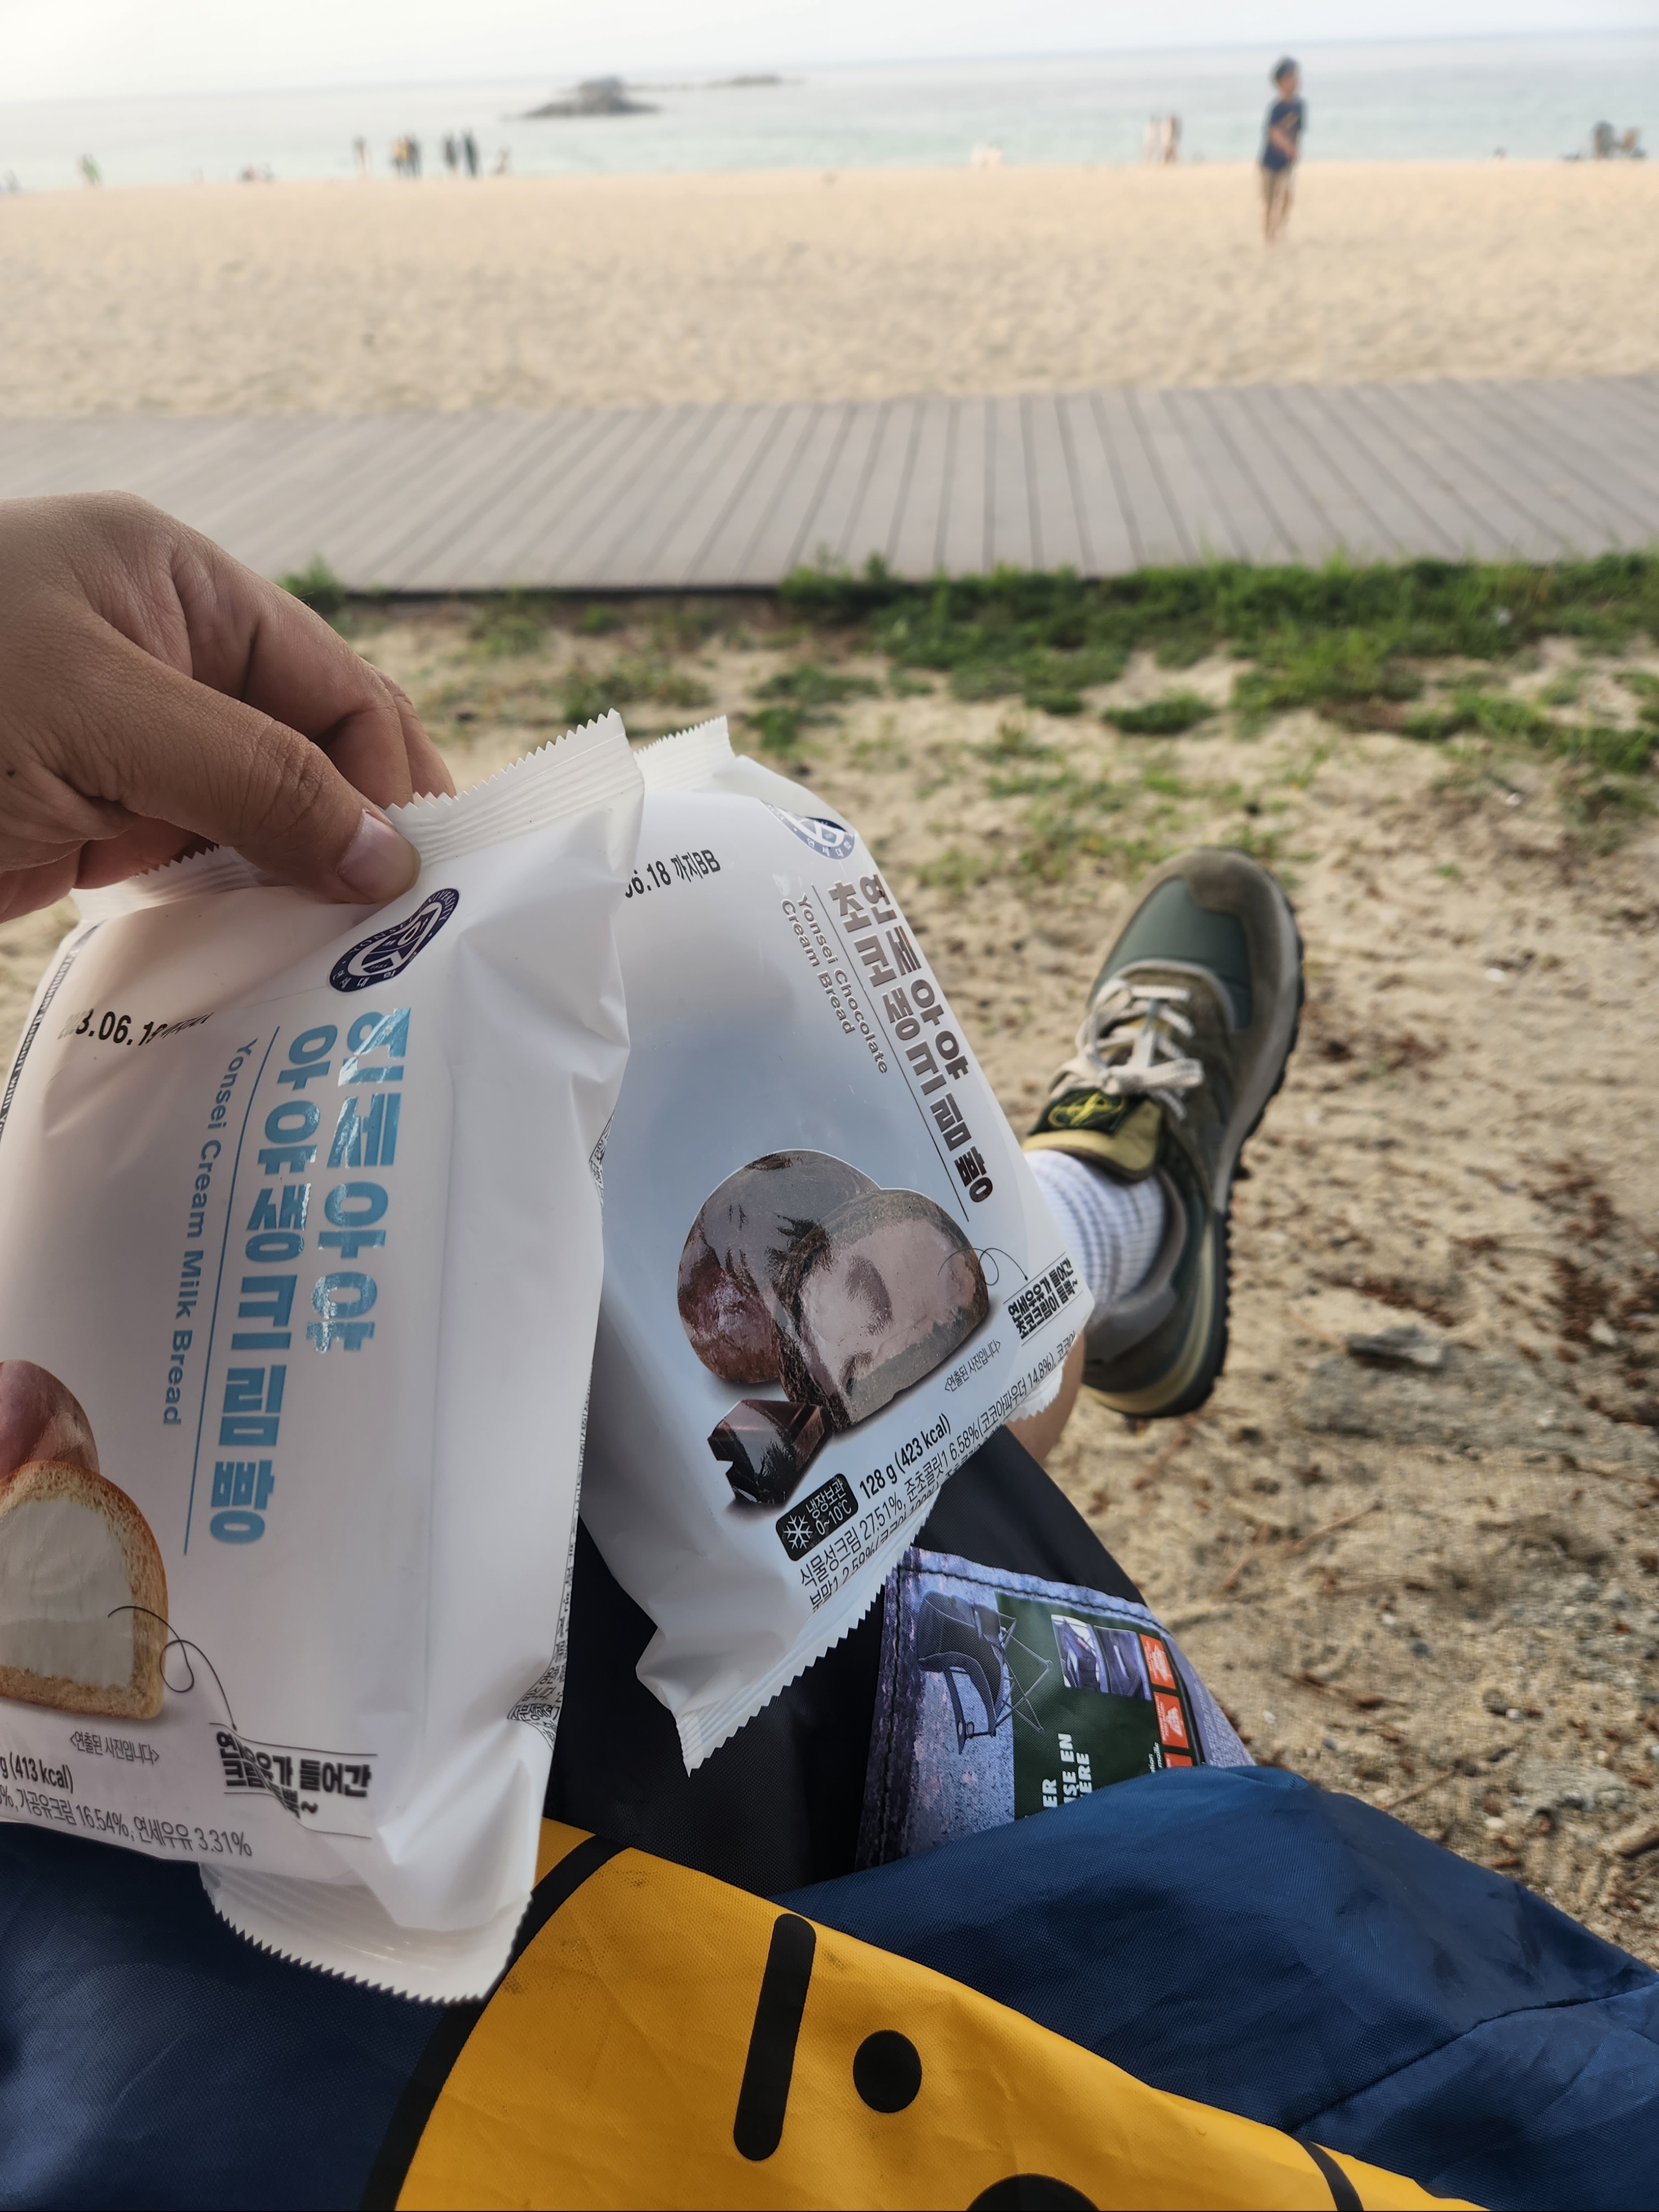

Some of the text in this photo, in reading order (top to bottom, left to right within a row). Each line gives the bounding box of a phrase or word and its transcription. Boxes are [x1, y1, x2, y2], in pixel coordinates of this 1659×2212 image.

[670, 849, 721, 882] 까지BB
[781, 899, 855, 1034] Cream Bread
[797, 893, 888, 1074] Yonsei Chocolate
[859, 874, 969, 1080] 연세우유
[828, 881, 993, 1203] 초코생크림빵
[306, 1008, 411, 1354] 연세우유
[163, 1038, 258, 1425] Yonsei Cream Milk Bread
[209, 1024, 338, 1545] 우유생크림빵
[1008, 1258, 1074, 1323] 연세우유가 들어간
[1016, 1293, 1060, 1340] 초코크림이
[805, 1478, 847, 1519] 냉장보관
[859, 1469, 885, 1499] 128
[886, 1464, 898, 1484] g
[894, 1437, 924, 1474] (423
[921, 1413, 951, 1450] kcal)
[800, 1526, 862, 1587] 식물성크림
[859, 1492, 907, 1541] 27.51%,
[10, 1751, 38, 1782] (413
[39, 1759, 74, 1794] kcal)
[299, 1759, 372, 1798] 들어간
[1058, 1733, 1074, 1762] EN
[16, 1789, 77, 1825] 가공유크림
[76, 1804, 135, 1841] 16.54%,
[134, 1816, 194, 1851] 연세우유
[195, 1827, 253, 1858] 3.31%
